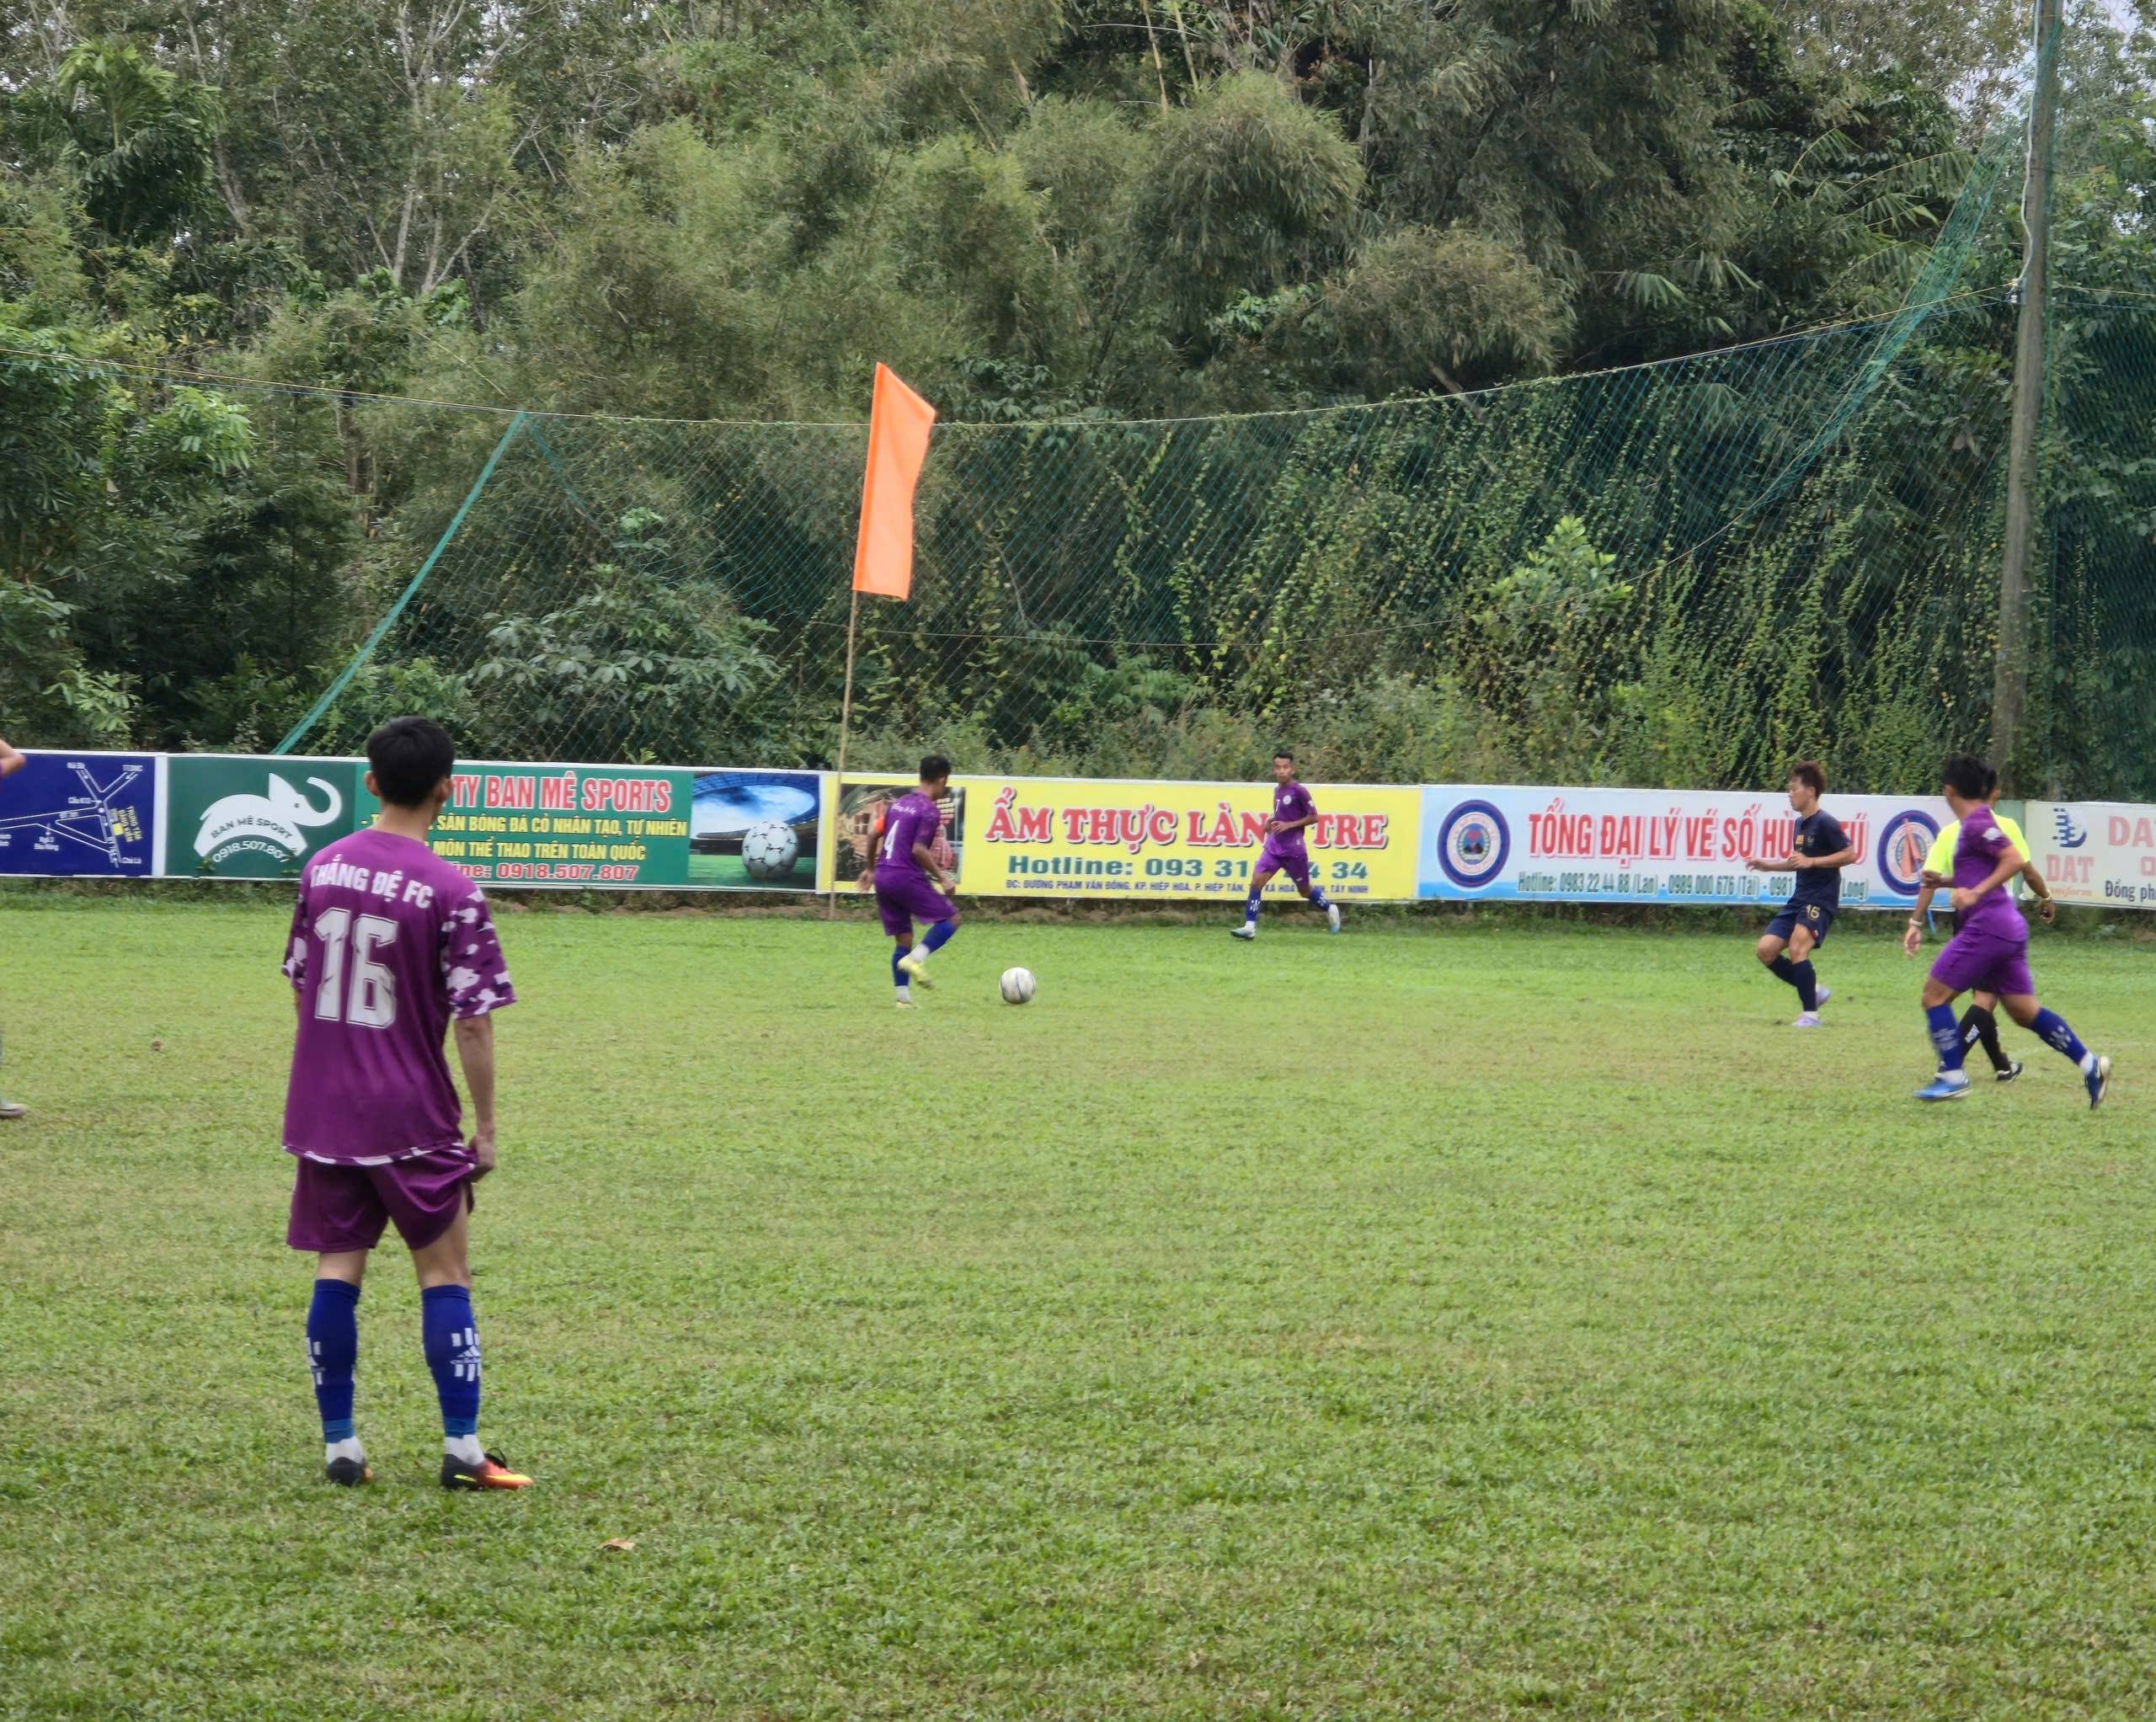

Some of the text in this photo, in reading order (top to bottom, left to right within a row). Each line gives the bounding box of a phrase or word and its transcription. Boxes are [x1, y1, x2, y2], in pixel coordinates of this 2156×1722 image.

[451, 770, 671, 813] TY BAN MÊ SPORTS
[211, 815, 294, 840] BAN MÊ SPORT
[436, 813, 465, 831] SÂN
[469, 813, 506, 832] BÓNG
[510, 814, 528, 833] ĐÁ
[531, 813, 550, 834] CỎ
[552, 815, 590, 834] NHÂN
[626, 818, 645, 838] TỰ
[645, 818, 688, 836] NHIÊN
[985, 786, 1388, 854] ẨM THỰC LÀN TRE
[1529, 797, 1595, 857] TỔNG
[1599, 814, 1642, 868] ĐẠI
[1648, 808, 1681, 860] LÝ
[1685, 808, 1718, 861] VÉ
[1721, 803, 1761, 861] SỐ
[433, 839, 465, 857] MÔN
[497, 842, 531, 858] THAO
[534, 840, 568, 859] TRÊN
[572, 841, 607, 860] TOÀN
[610, 840, 646, 861] QUỐC
[884, 819, 899, 859] 4
[497, 862, 640, 880] 0918.507.807
[1008, 856, 1133, 876] Hotline:
[1145, 858, 1203, 877] 093
[1214, 860, 1247, 877] 31
[1331, 861, 1368, 879] 34
[1518, 871, 1556, 892] Hotline:
[1587, 872, 1599, 893] 22
[371, 870, 403, 903] ĐỆ
[402, 880, 434, 909] FC
[314, 907, 398, 1028] 16
